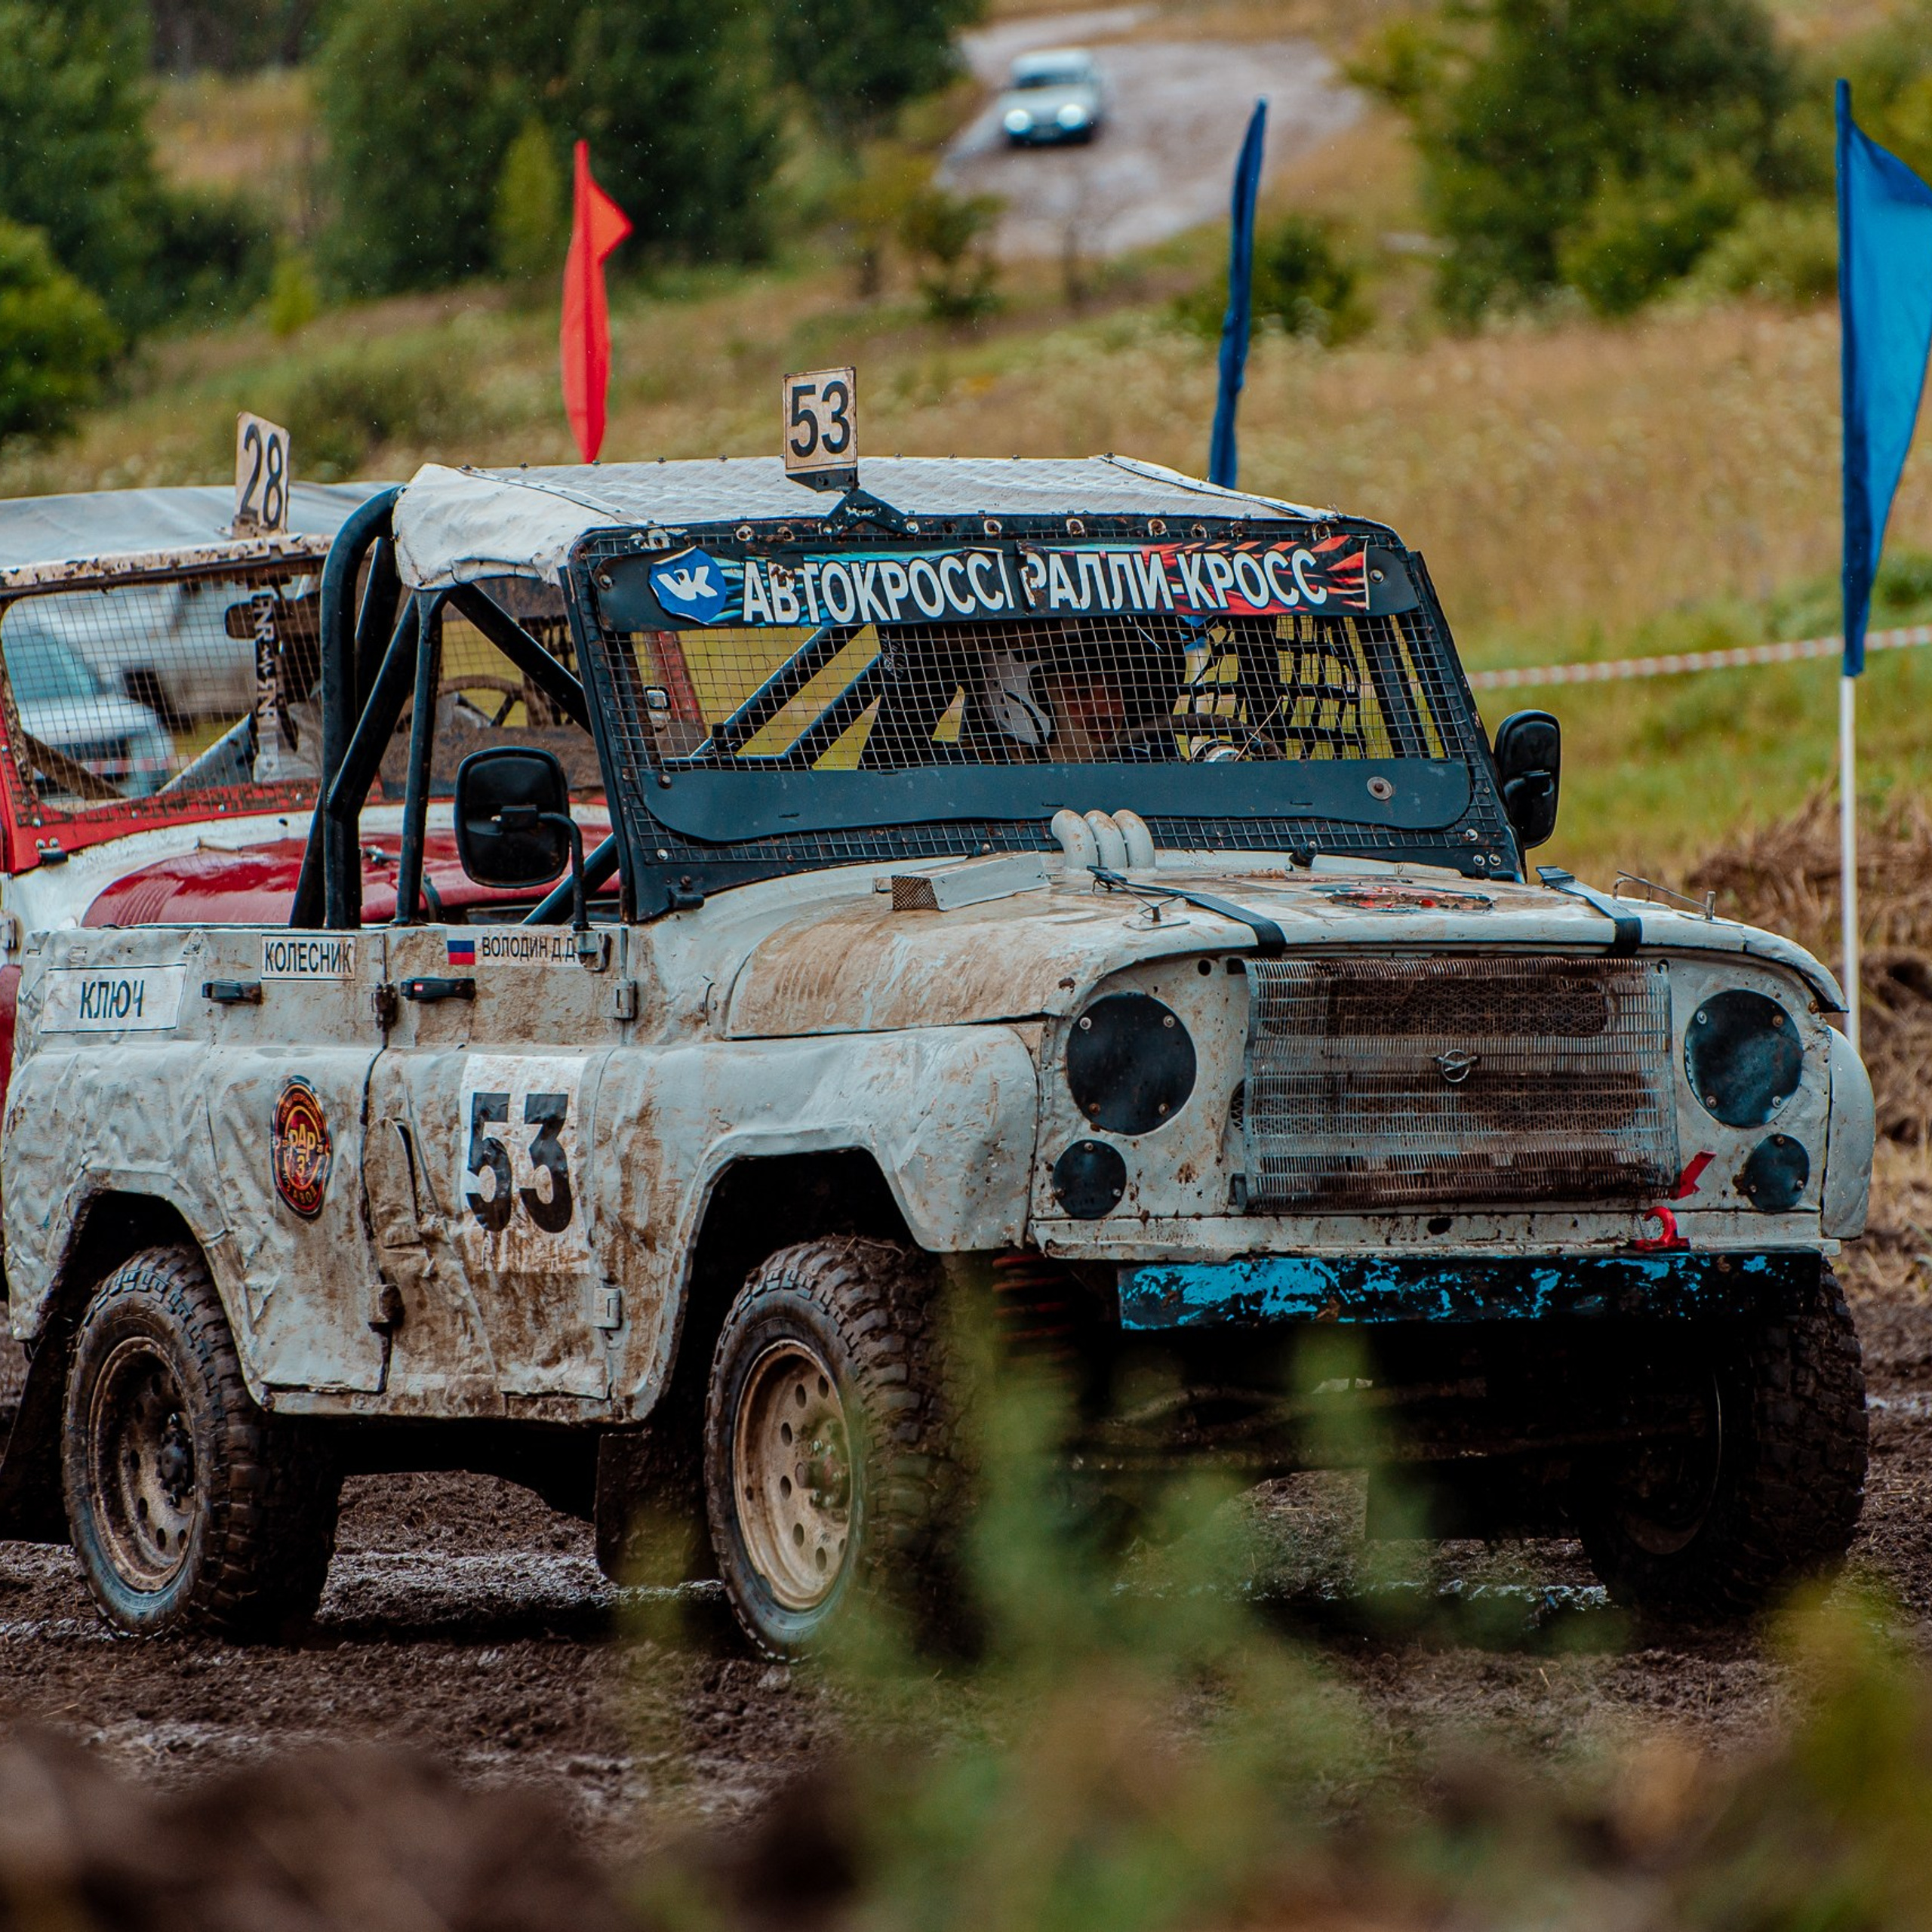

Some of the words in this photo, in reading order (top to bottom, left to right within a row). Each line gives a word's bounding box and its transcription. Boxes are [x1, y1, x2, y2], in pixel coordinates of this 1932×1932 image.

[789, 380, 851, 458] 53
[239, 423, 283, 530] 28
[743, 552, 1004, 624] АВТОКРОСС
[1020, 548, 1327, 612] РАЛЛИ-КРОСС
[264, 941, 352, 974] КОЛЕСНИК
[481, 936, 548, 961] ВОЛОДИН
[78, 980, 145, 1020] КЛЮЧ
[465, 1091, 574, 1234] 53
